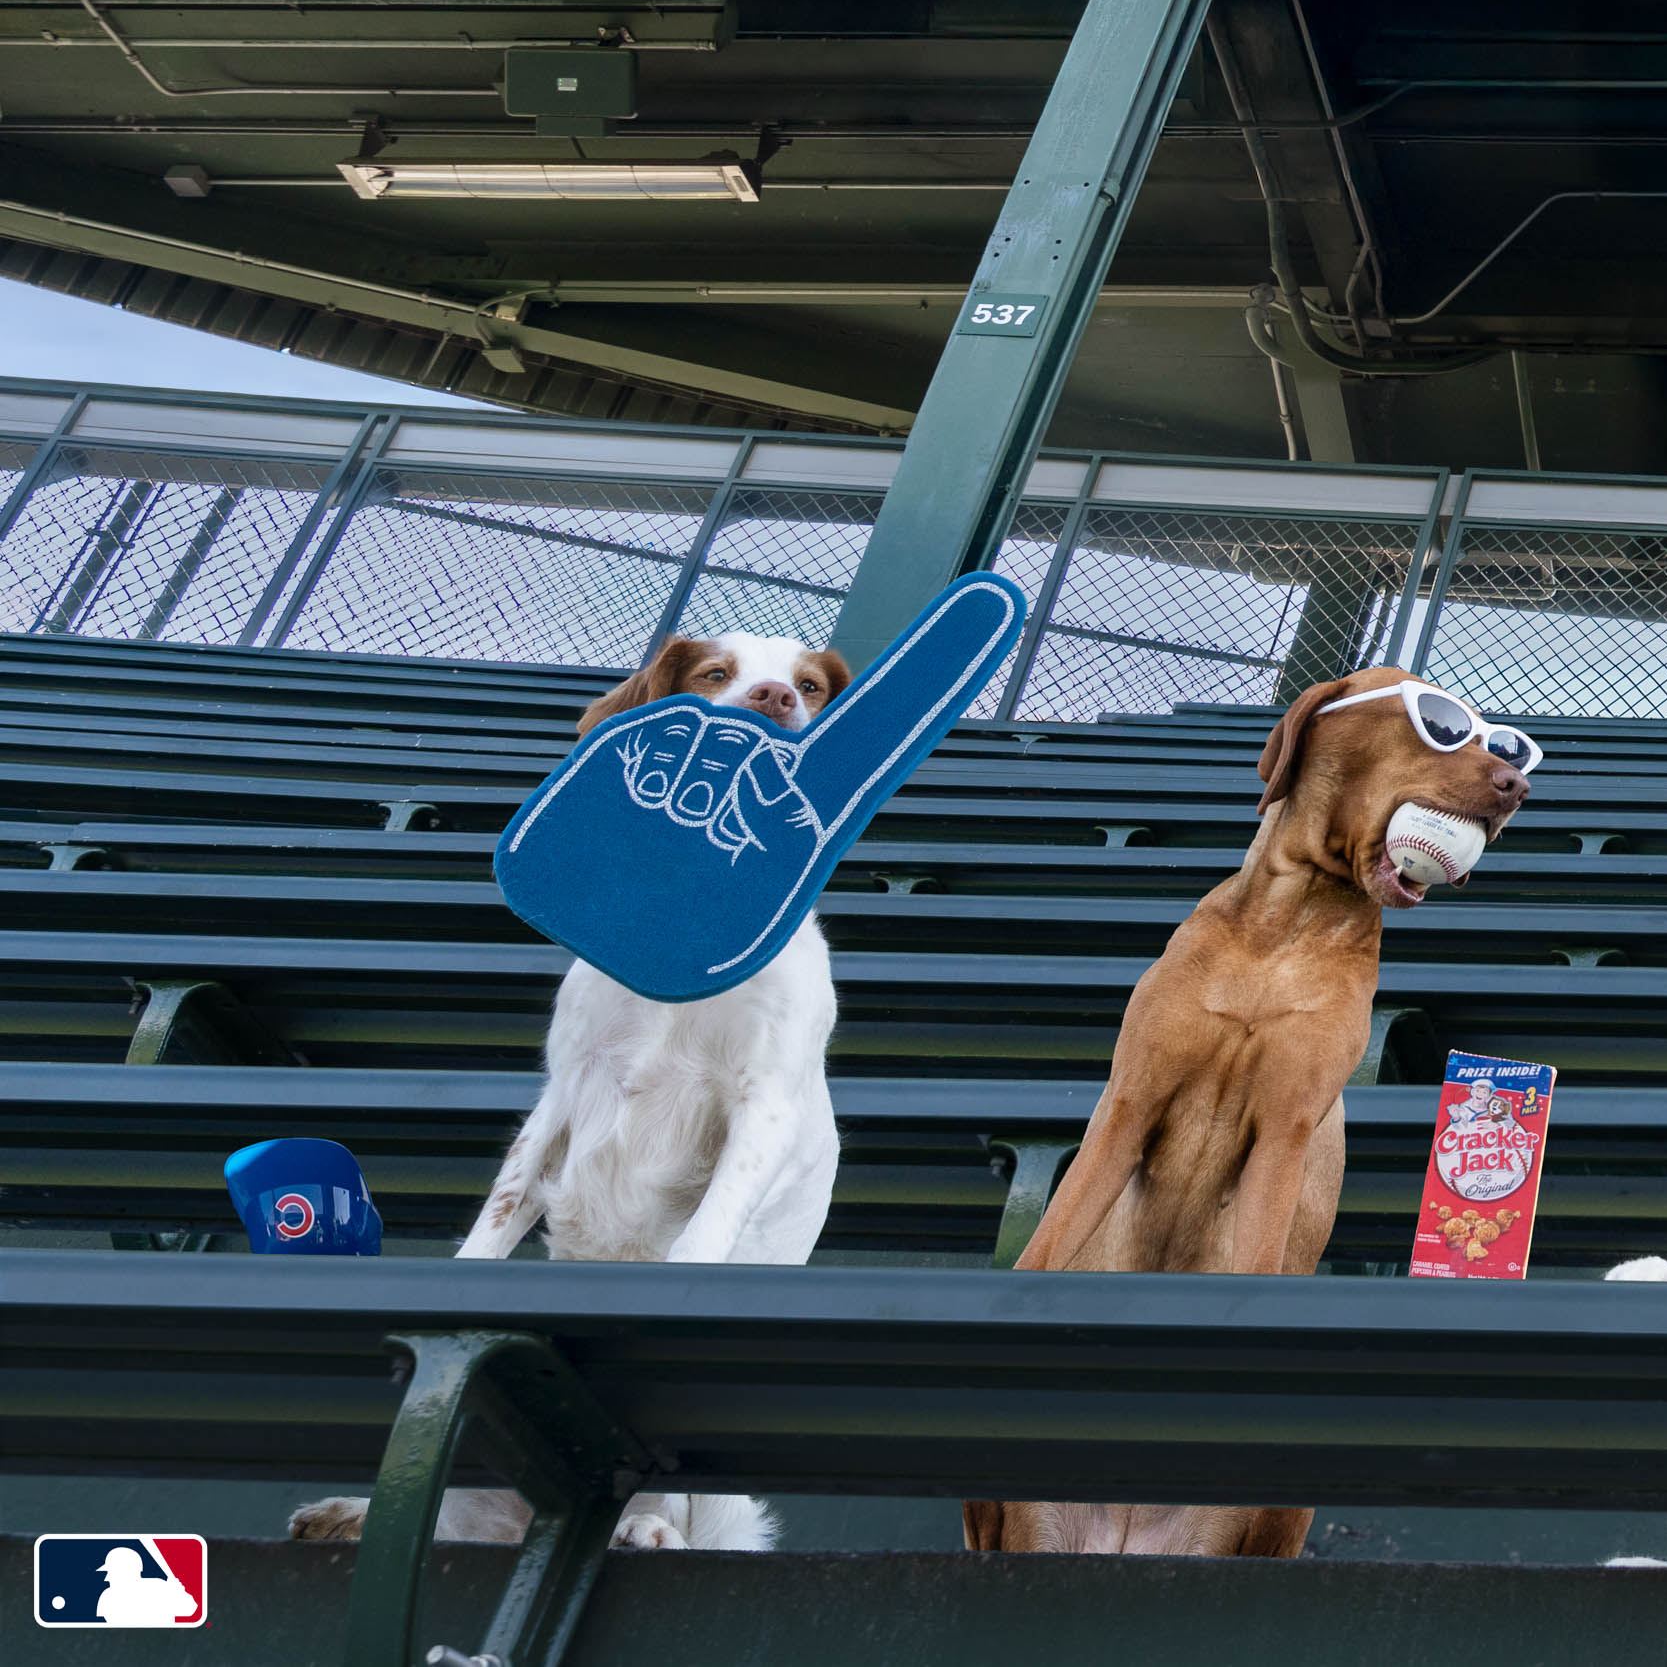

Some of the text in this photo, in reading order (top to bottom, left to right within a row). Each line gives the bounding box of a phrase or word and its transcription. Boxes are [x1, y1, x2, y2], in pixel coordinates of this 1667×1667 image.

[971, 302, 1036, 326] 537
[1456, 1065, 1541, 1078] PRIZE INSIDE!
[1524, 1086, 1537, 1106] 3
[1436, 1126, 1539, 1155] Cracker
[1450, 1149, 1513, 1177] Jack
[1465, 1179, 1514, 1198] Original
